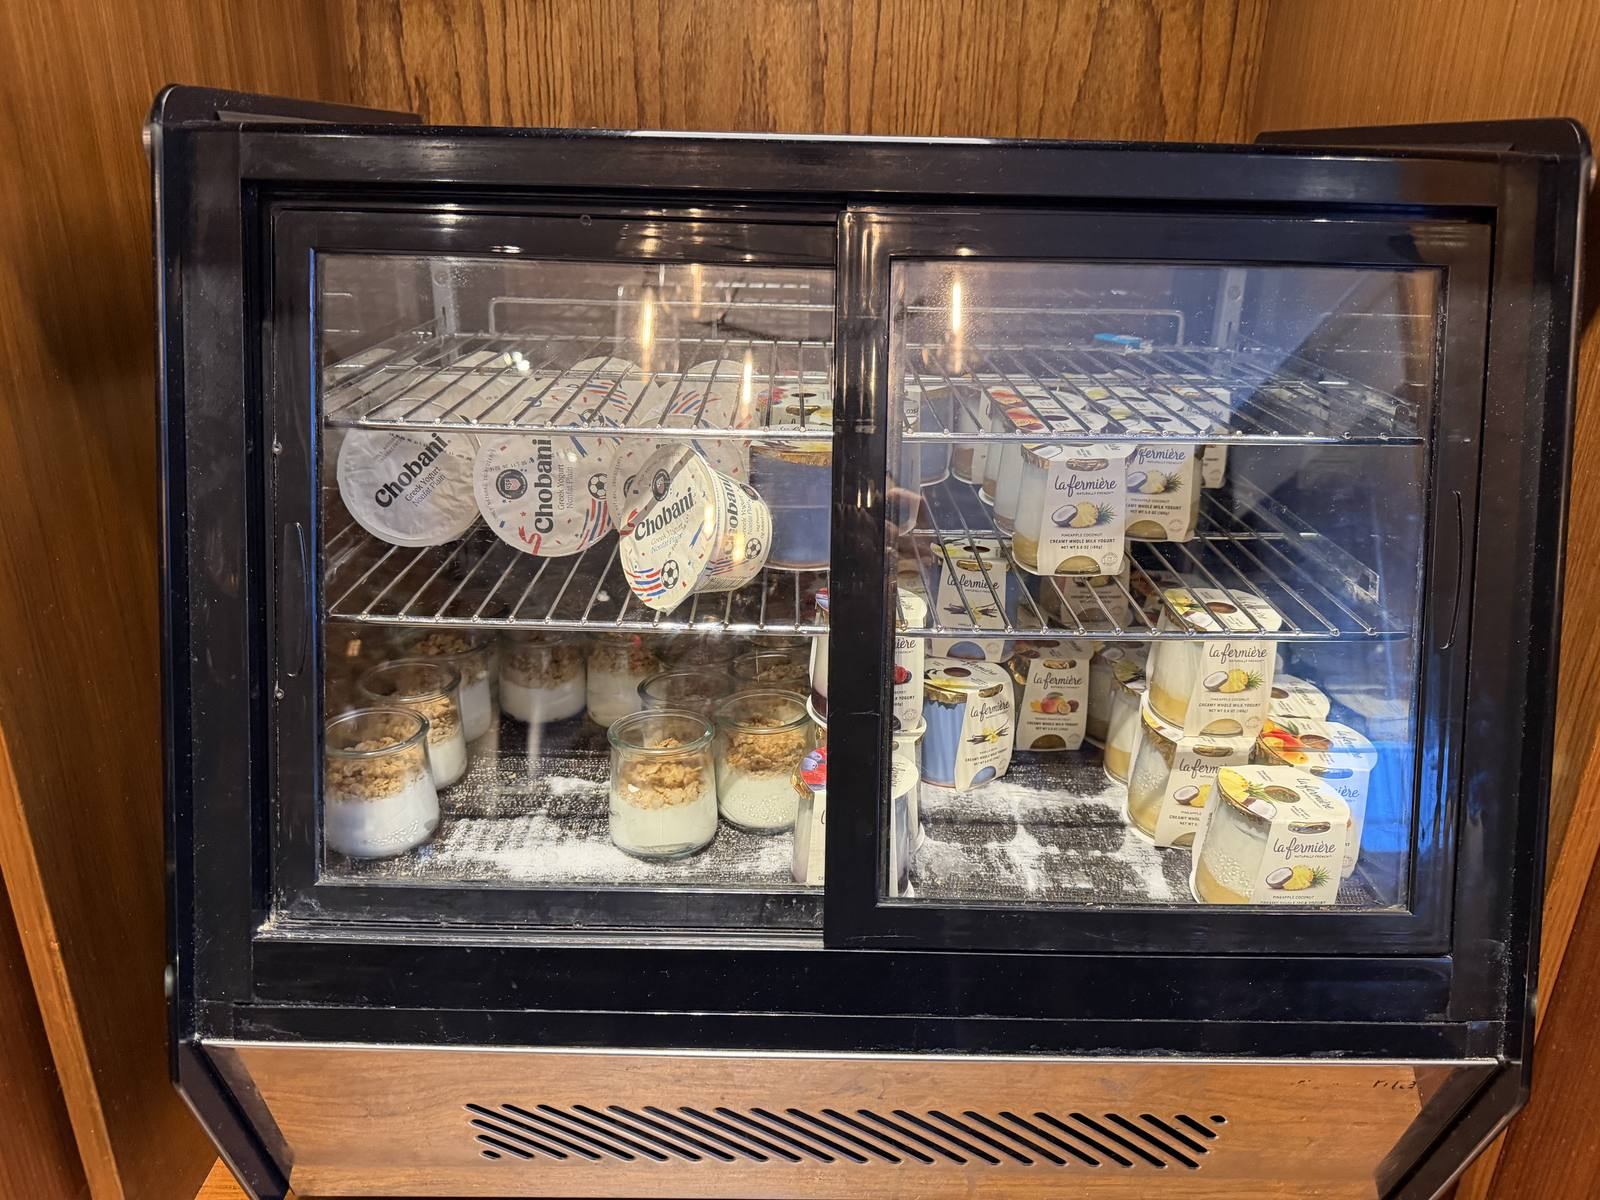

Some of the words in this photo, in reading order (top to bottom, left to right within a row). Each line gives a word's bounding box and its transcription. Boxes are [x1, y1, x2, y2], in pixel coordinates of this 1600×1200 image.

[375, 432, 449, 508] Chobani
[557, 464, 566, 489] Yogurt
[405, 485, 423, 501] Greek
[420, 466, 441, 486] Yogurt
[532, 439, 554, 534] Chobani
[1054, 475, 1067, 491] la
[1066, 474, 1117, 497] fermière
[557, 490, 566, 510] Greek
[634, 487, 694, 541] Chobani
[1209, 643, 1220, 658] la
[1220, 642, 1268, 665] fermière
[1033, 672, 1044, 684] la
[1042, 672, 1083, 690] fermière
[970, 705, 979, 718] la
[979, 700, 1011, 722] fermière
[1179, 758, 1191, 772] la
[1273, 838, 1285, 853] la
[1284, 836, 1337, 860] fermière
